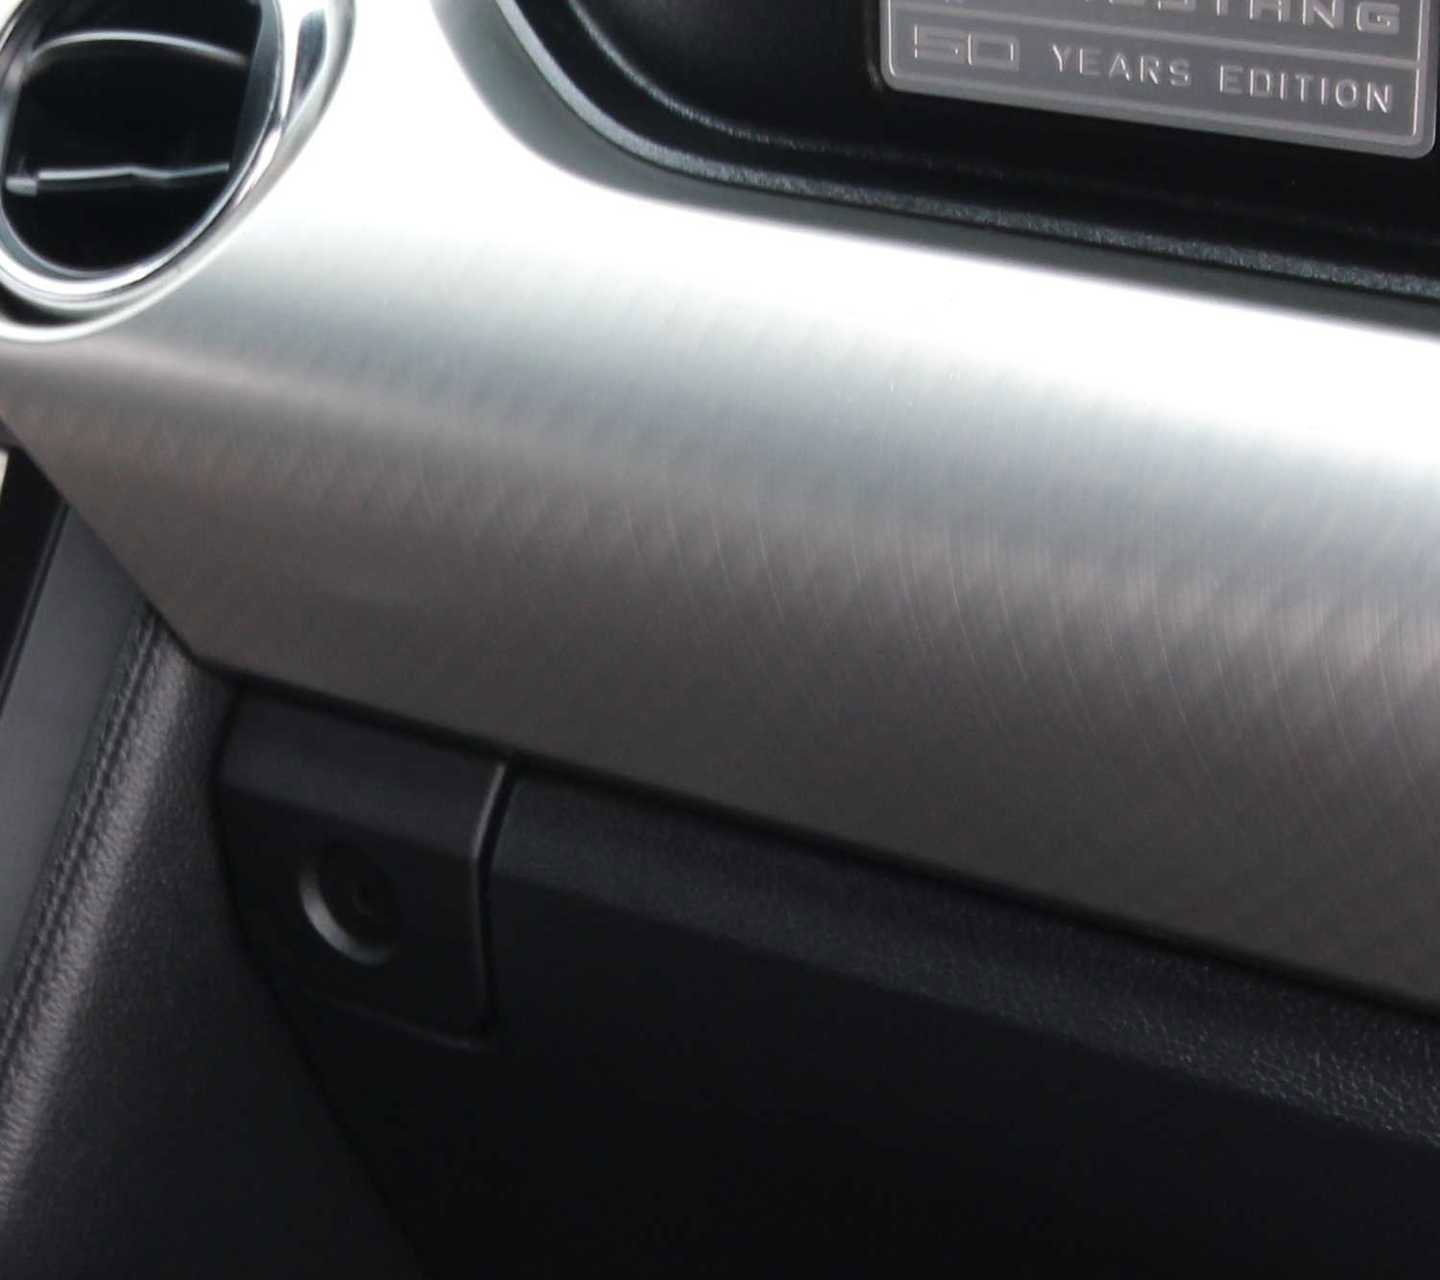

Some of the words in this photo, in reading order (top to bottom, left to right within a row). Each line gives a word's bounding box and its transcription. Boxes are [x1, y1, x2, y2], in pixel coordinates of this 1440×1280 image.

[913, 23, 1017, 69] 50
[1051, 40, 1193, 88] YEARS
[1218, 63, 1392, 114] EDITION
